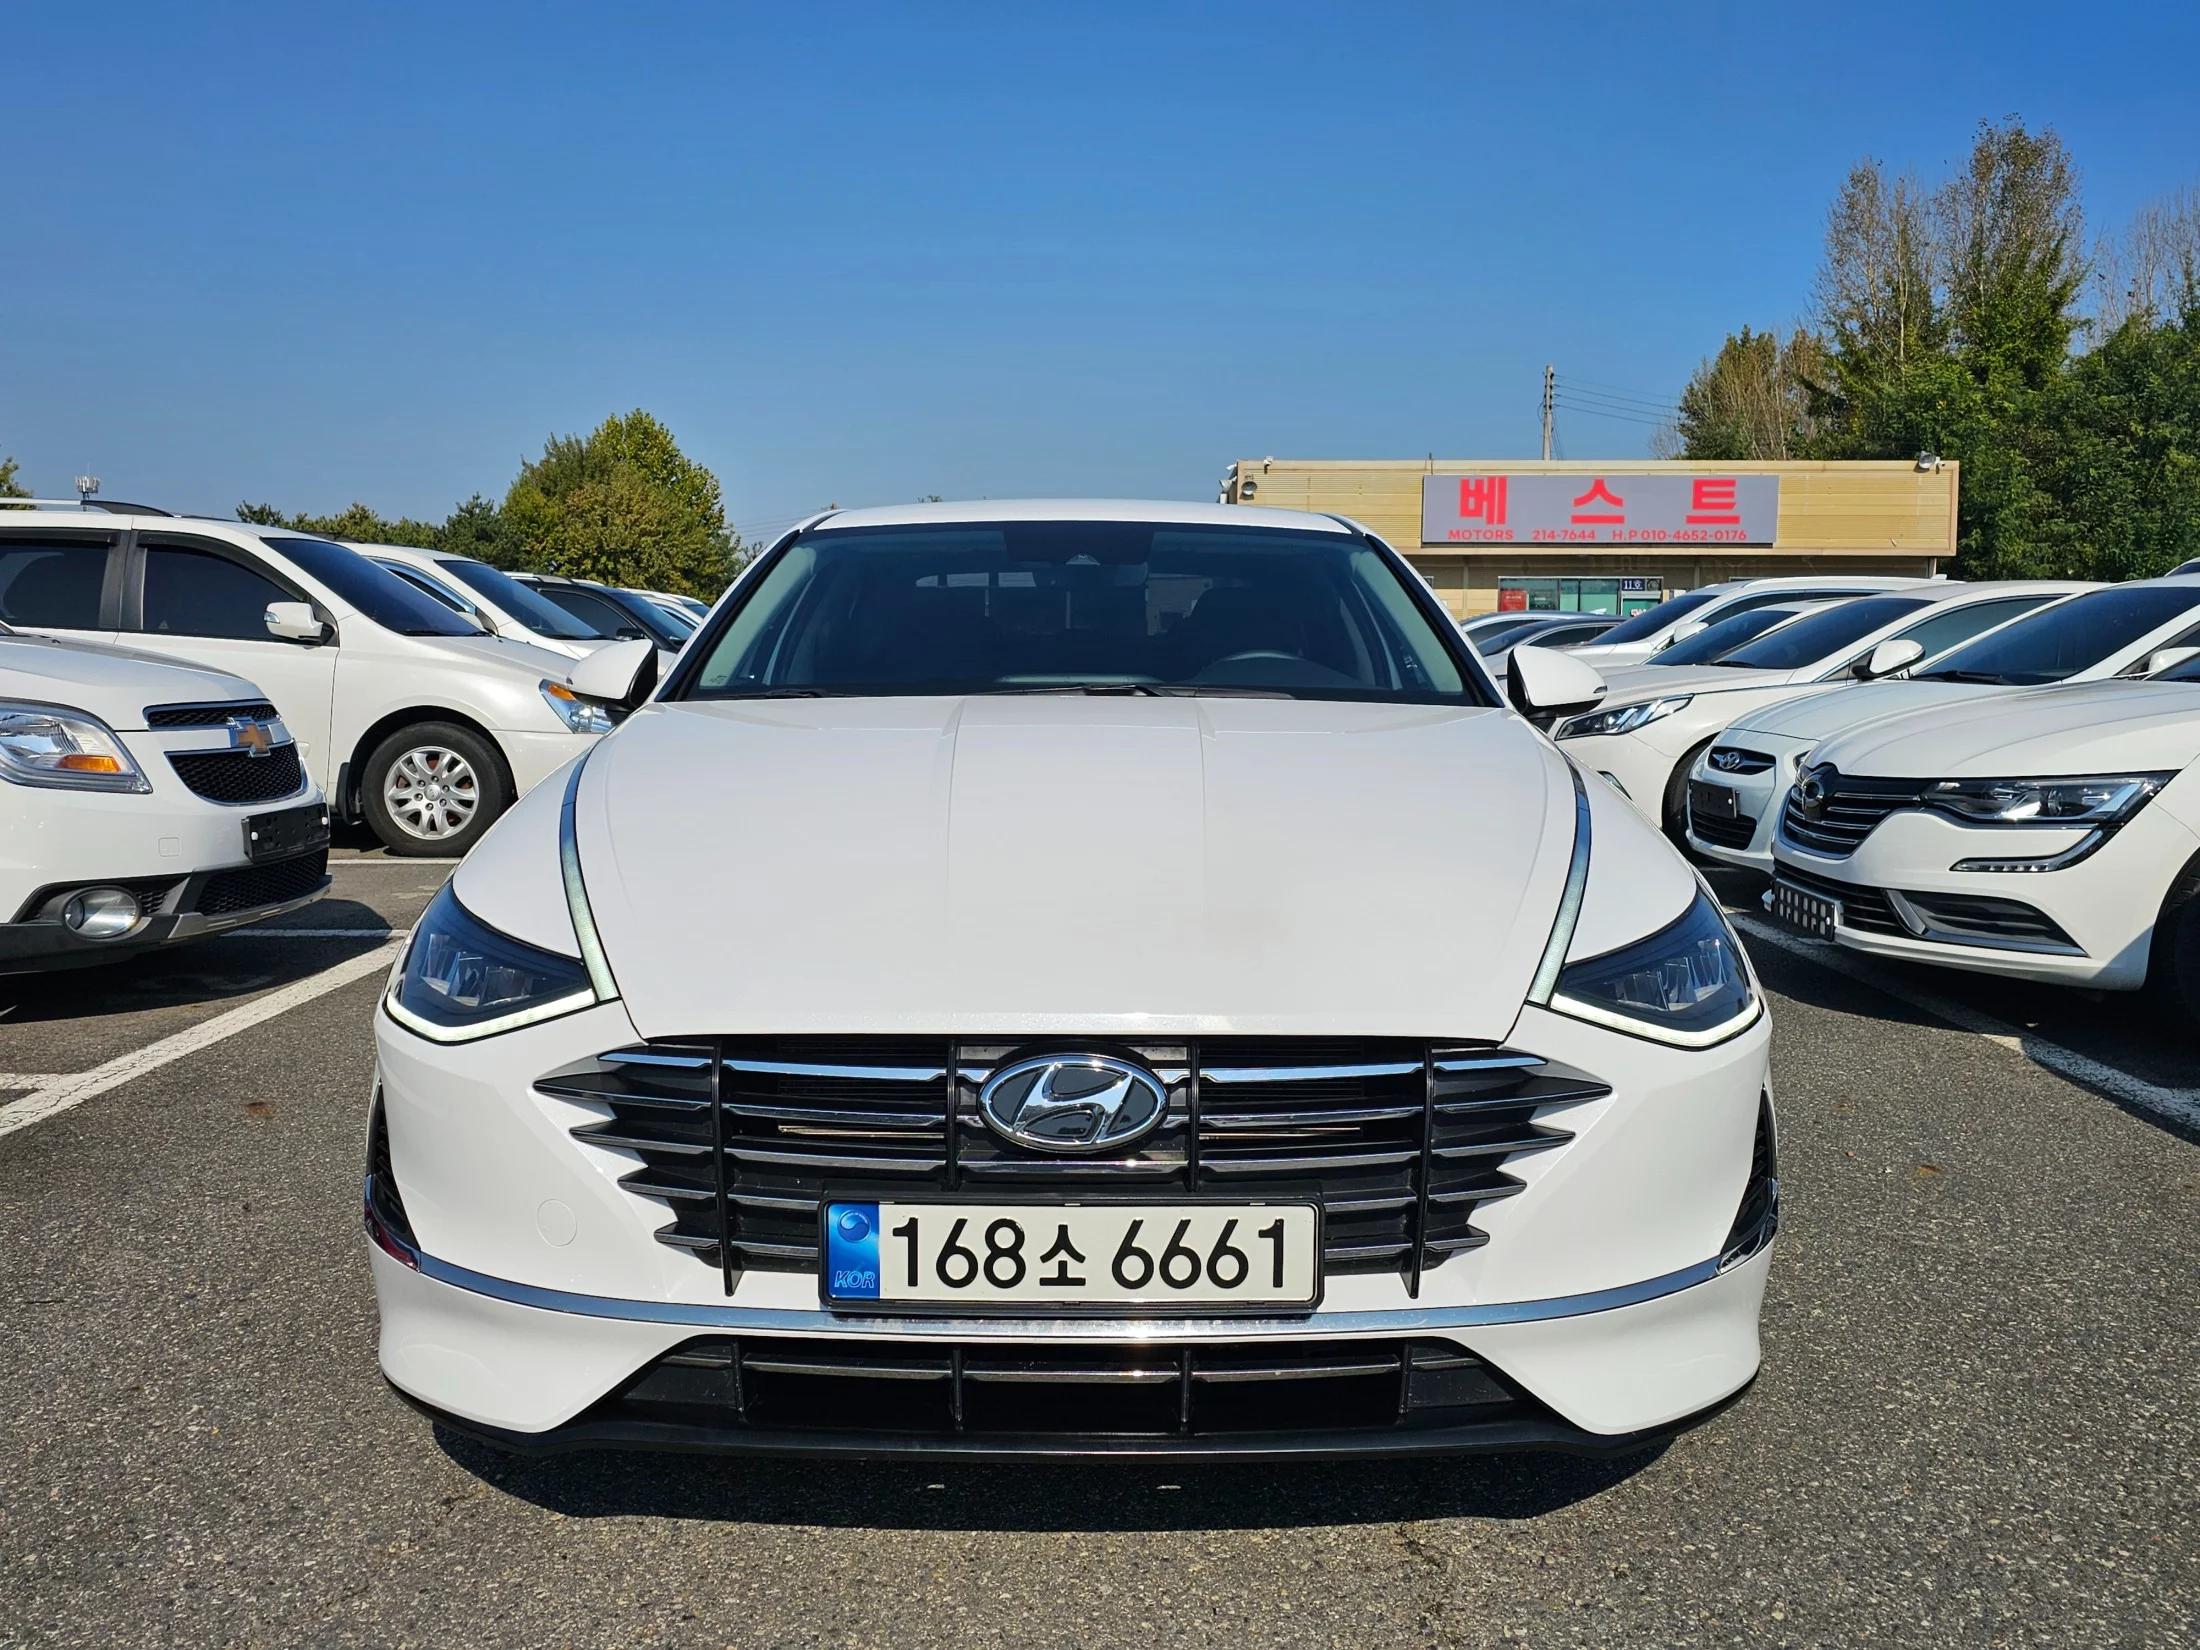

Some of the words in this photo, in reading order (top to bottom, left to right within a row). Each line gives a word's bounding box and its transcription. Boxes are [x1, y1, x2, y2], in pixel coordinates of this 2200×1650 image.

[1448, 529, 1514, 541] MOTORS
[1532, 529, 1596, 541] 214-7644
[892, 1216, 1087, 1289] 168소
[1111, 1218, 1285, 1290] 6661
[834, 1270, 875, 1288] KOR
